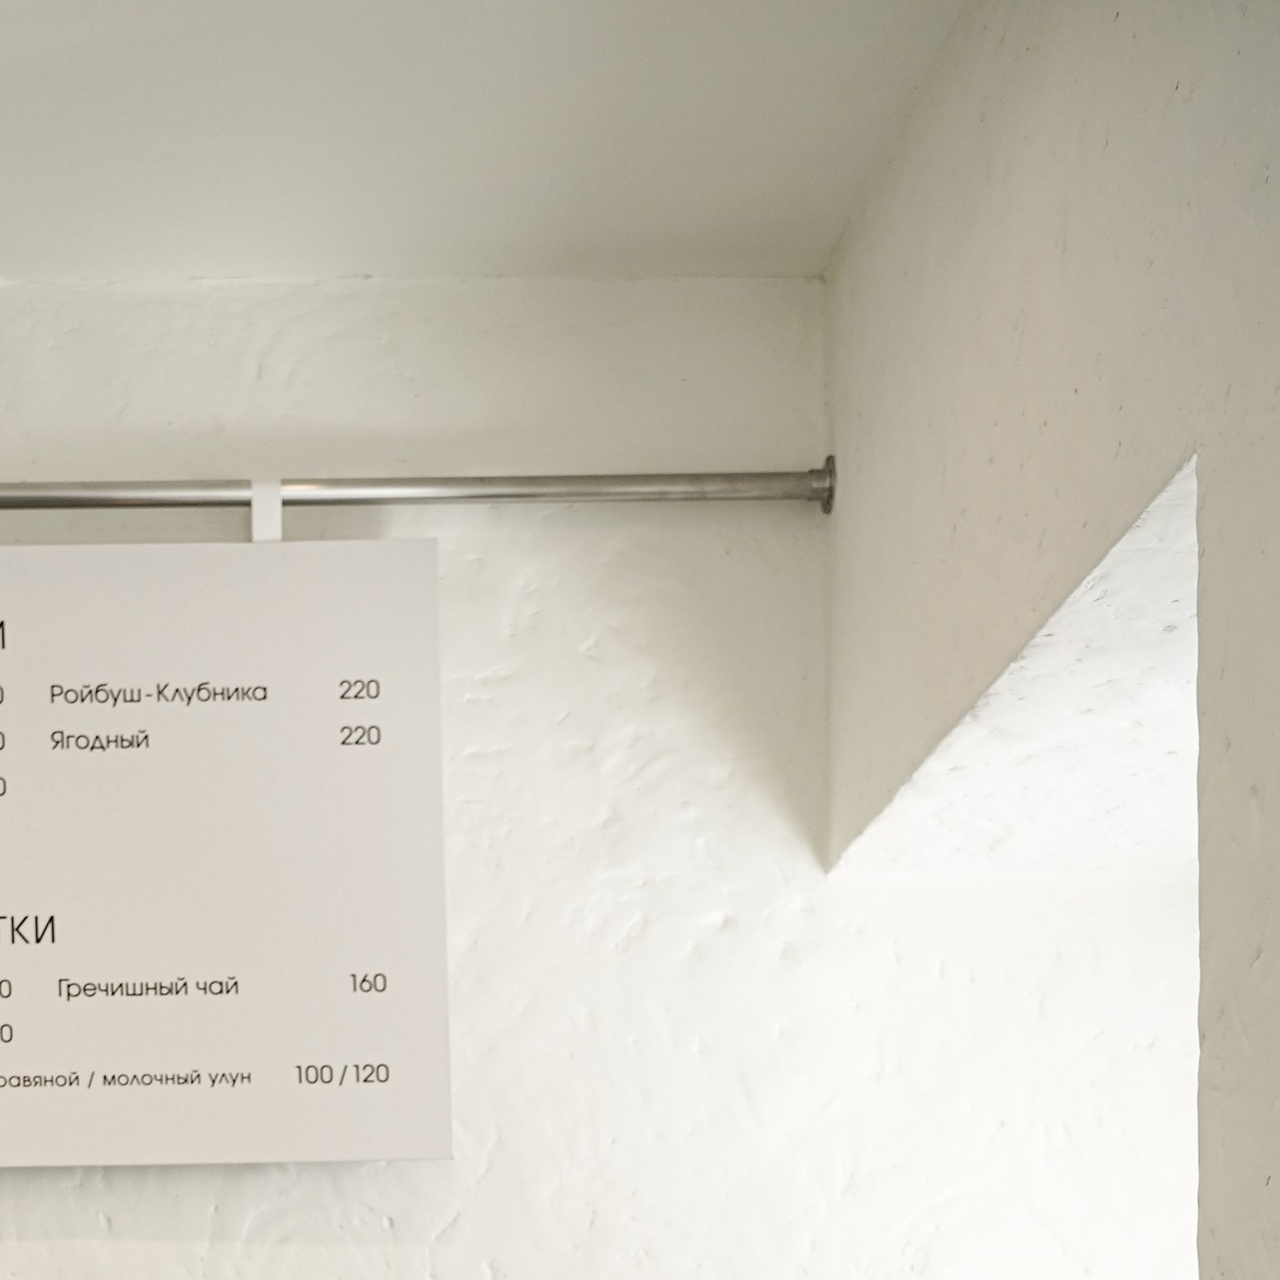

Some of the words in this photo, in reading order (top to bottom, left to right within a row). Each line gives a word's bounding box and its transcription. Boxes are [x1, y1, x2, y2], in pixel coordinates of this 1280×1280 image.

[49, 681, 268, 708] Ройбуш-Клубника
[338, 679, 381, 701] 220
[49, 729, 150, 753] Ягодный
[339, 724, 382, 746] 220
[57, 976, 189, 1003] Гречишный
[195, 975, 240, 996] чай
[349, 972, 388, 994] 160
[102, 1069, 202, 1087] молочный
[207, 1071, 252, 1089] улун
